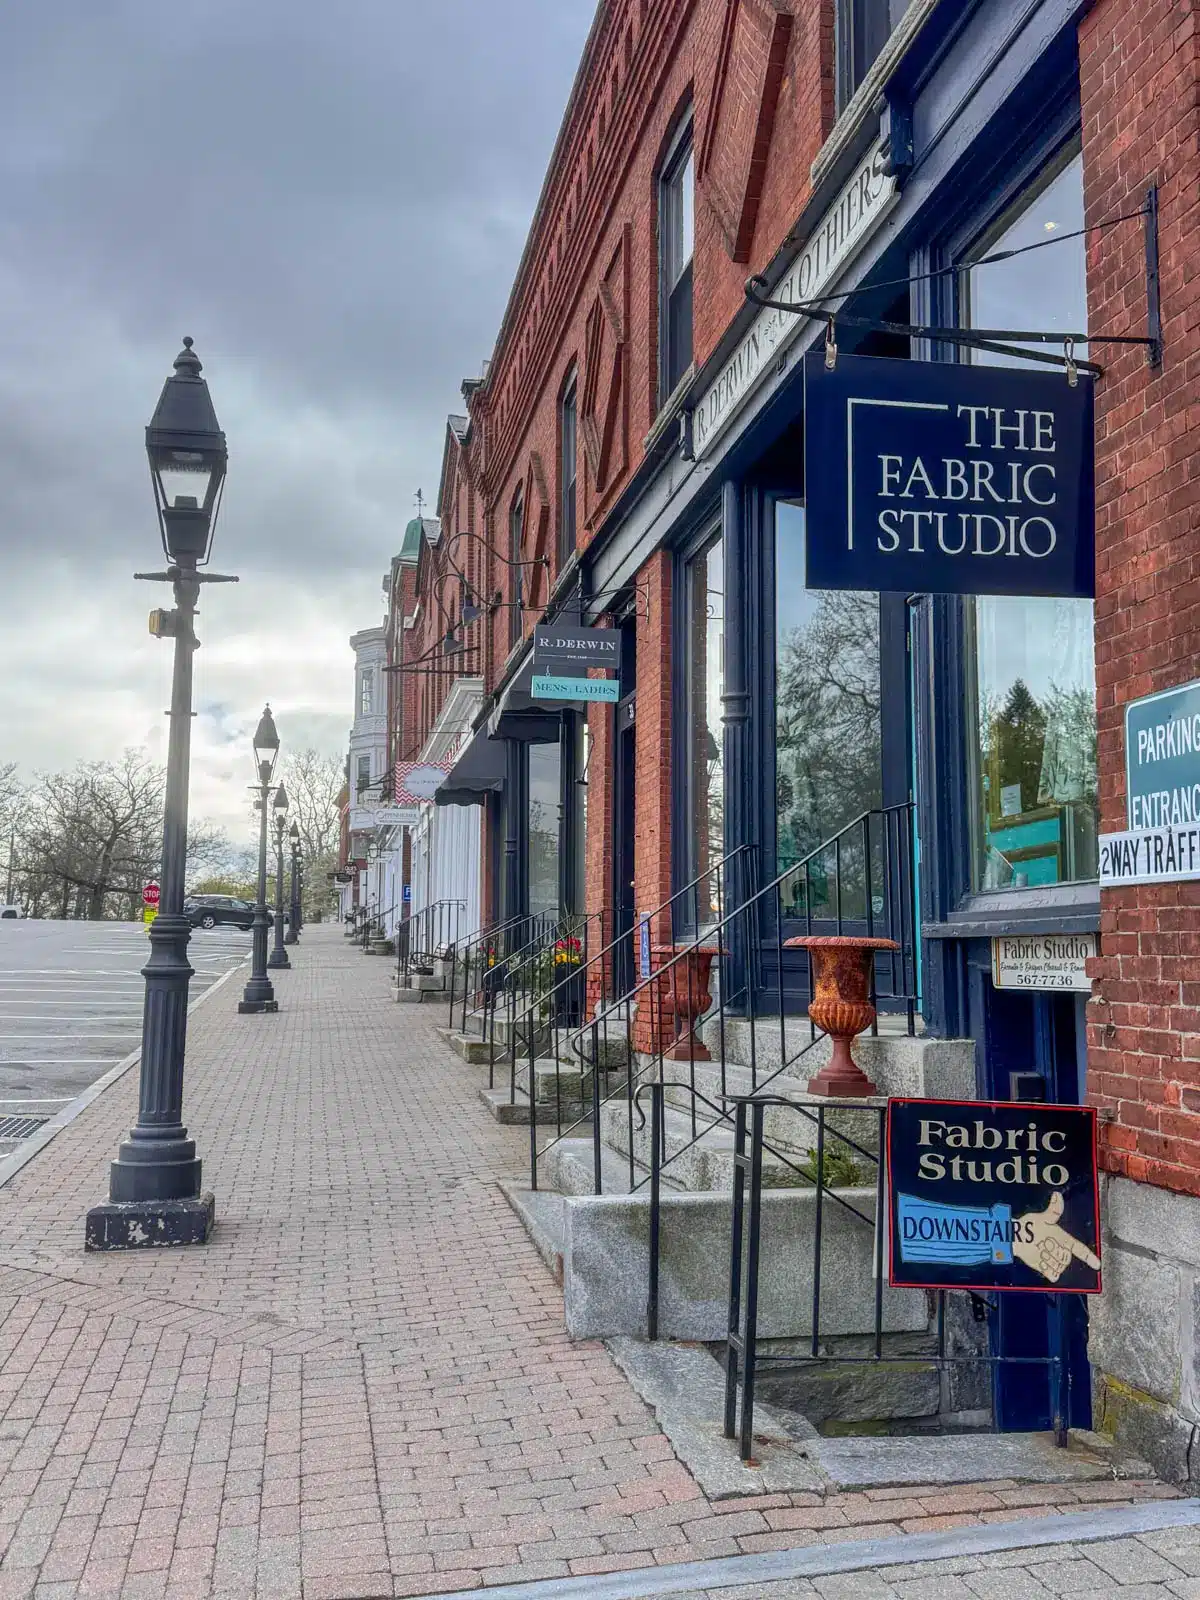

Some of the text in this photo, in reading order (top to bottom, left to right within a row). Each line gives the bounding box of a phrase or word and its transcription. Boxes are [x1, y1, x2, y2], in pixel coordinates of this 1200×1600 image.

[709, 323, 761, 426] DERWIN
[957, 404, 1056, 451] THE
[877, 454, 1056, 506] FABRIC
[877, 508, 1057, 558] STUDIO
[539, 637, 616, 651] R. DERWIN
[535, 682, 617, 696] MENS LADIES
[1137, 713, 1200, 765] PARKING
[143, 890, 160, 898] STOP
[1003, 938, 1088, 959] Fabric Studio
[916, 1119, 1067, 1153] Fabric
[917, 1153, 1070, 1186] Studio
[903, 1216, 1034, 1244] DOWNSTAIRS
